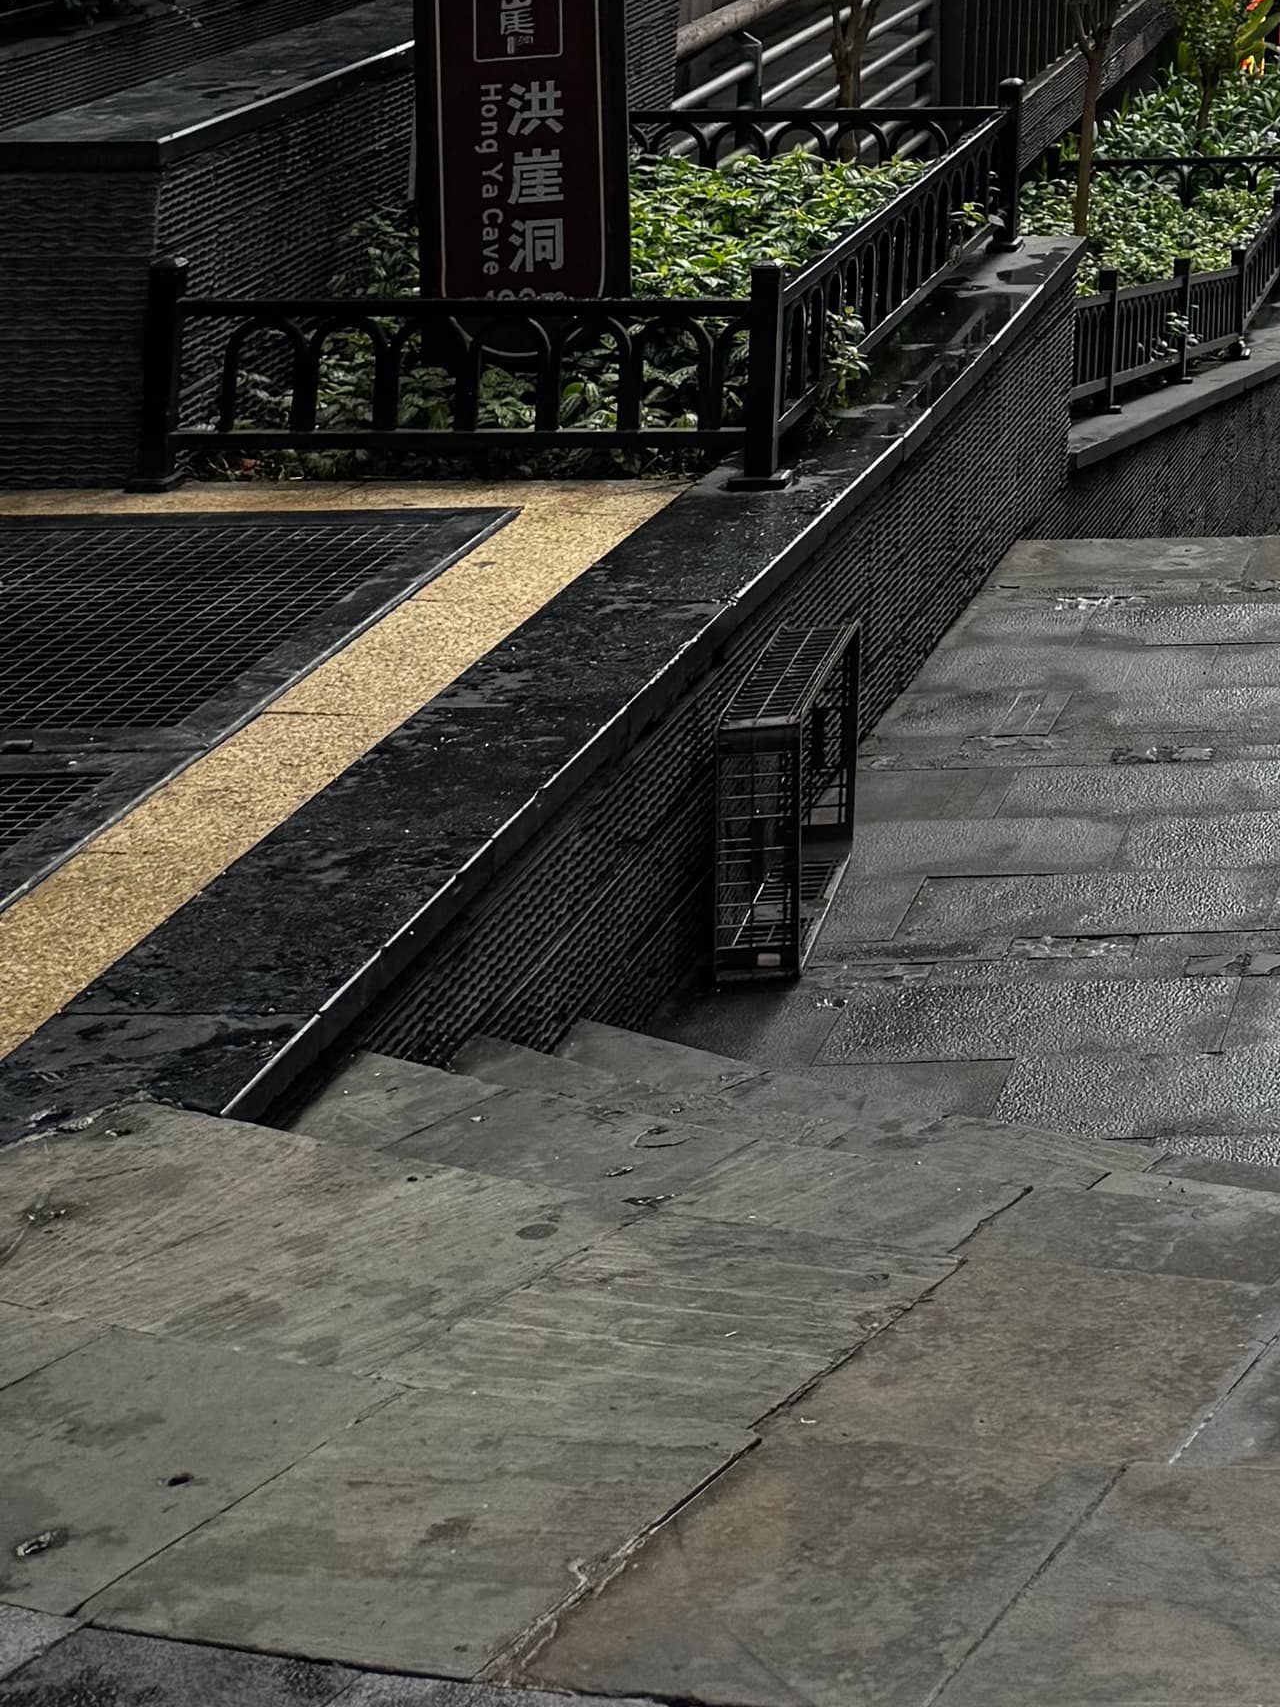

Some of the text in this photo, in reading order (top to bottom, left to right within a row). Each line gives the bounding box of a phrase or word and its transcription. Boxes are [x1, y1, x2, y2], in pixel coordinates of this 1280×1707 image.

[474, 83, 504, 276] Hong Ya Cave
[506, 80, 565, 273] 洪崖洞
